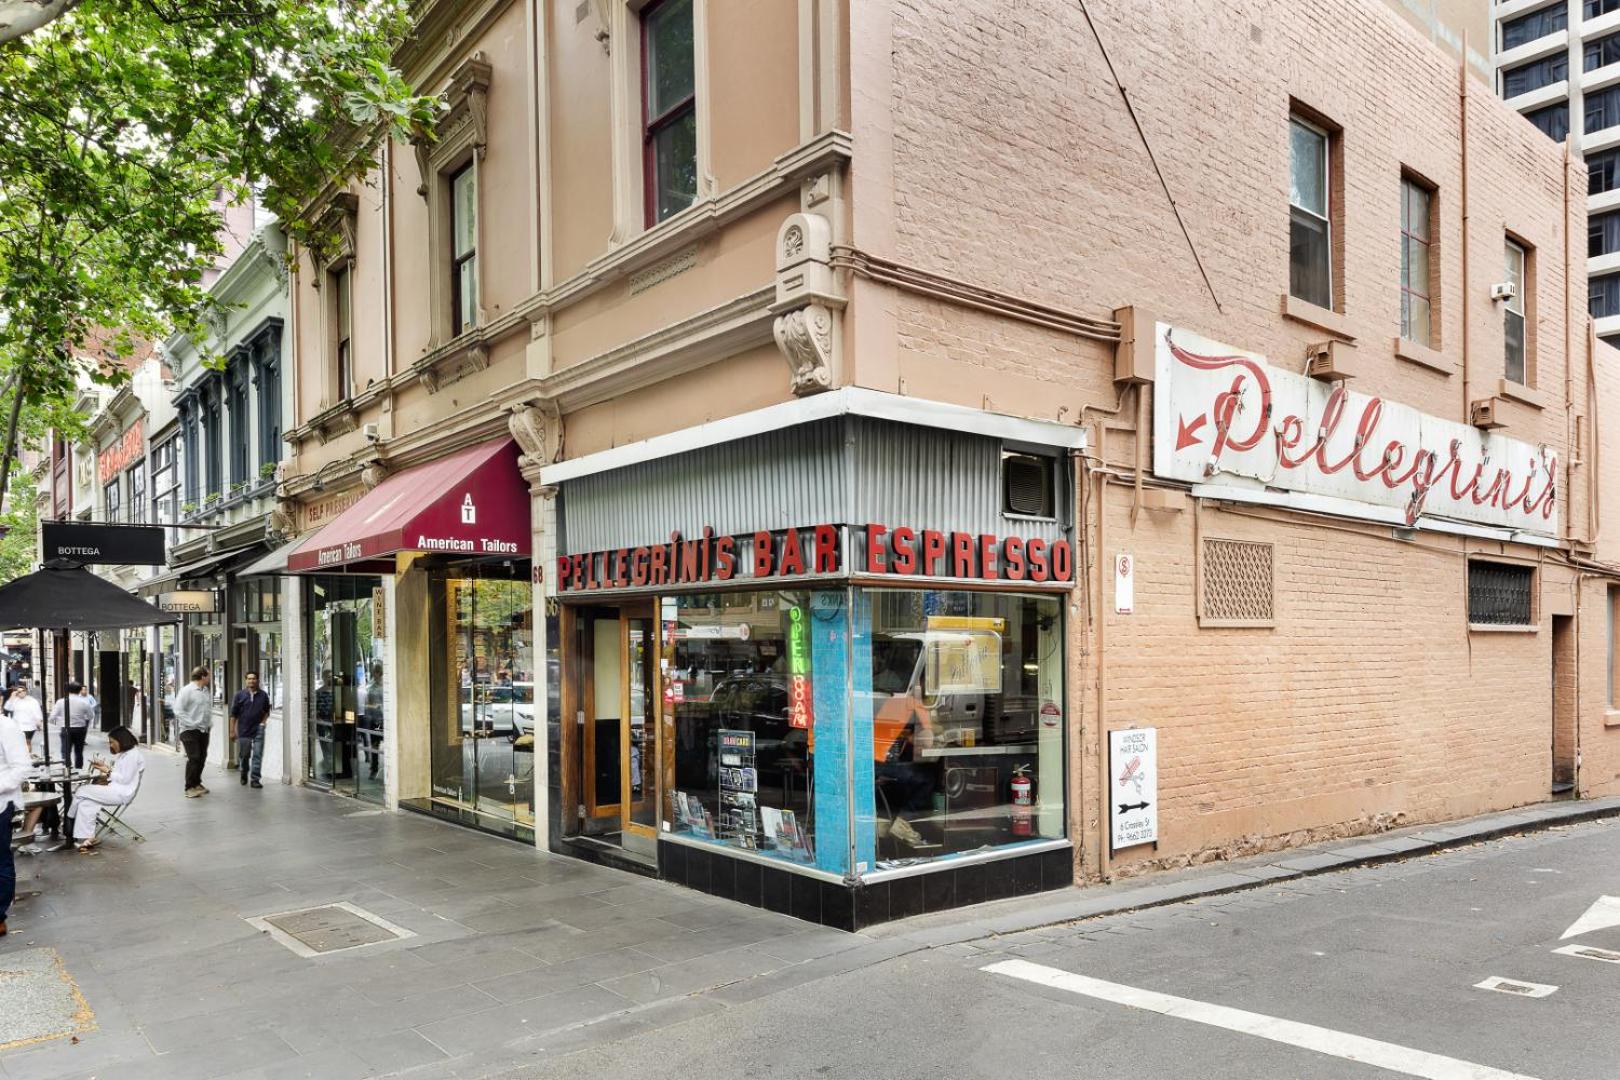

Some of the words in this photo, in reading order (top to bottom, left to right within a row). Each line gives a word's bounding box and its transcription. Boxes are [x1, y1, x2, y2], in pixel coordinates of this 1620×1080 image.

[58, 546, 100, 556] BOTTEGA
[318, 546, 342, 565] American
[343, 542, 362, 559] Tailors
[417, 535, 474, 551] American
[480, 538, 518, 553] Tailors
[755, 524, 838, 578] BAR
[866, 523, 1071, 582] ESPRESSO
[533, 565, 543, 584] 68
[161, 602, 201, 612] BOTTEGA
